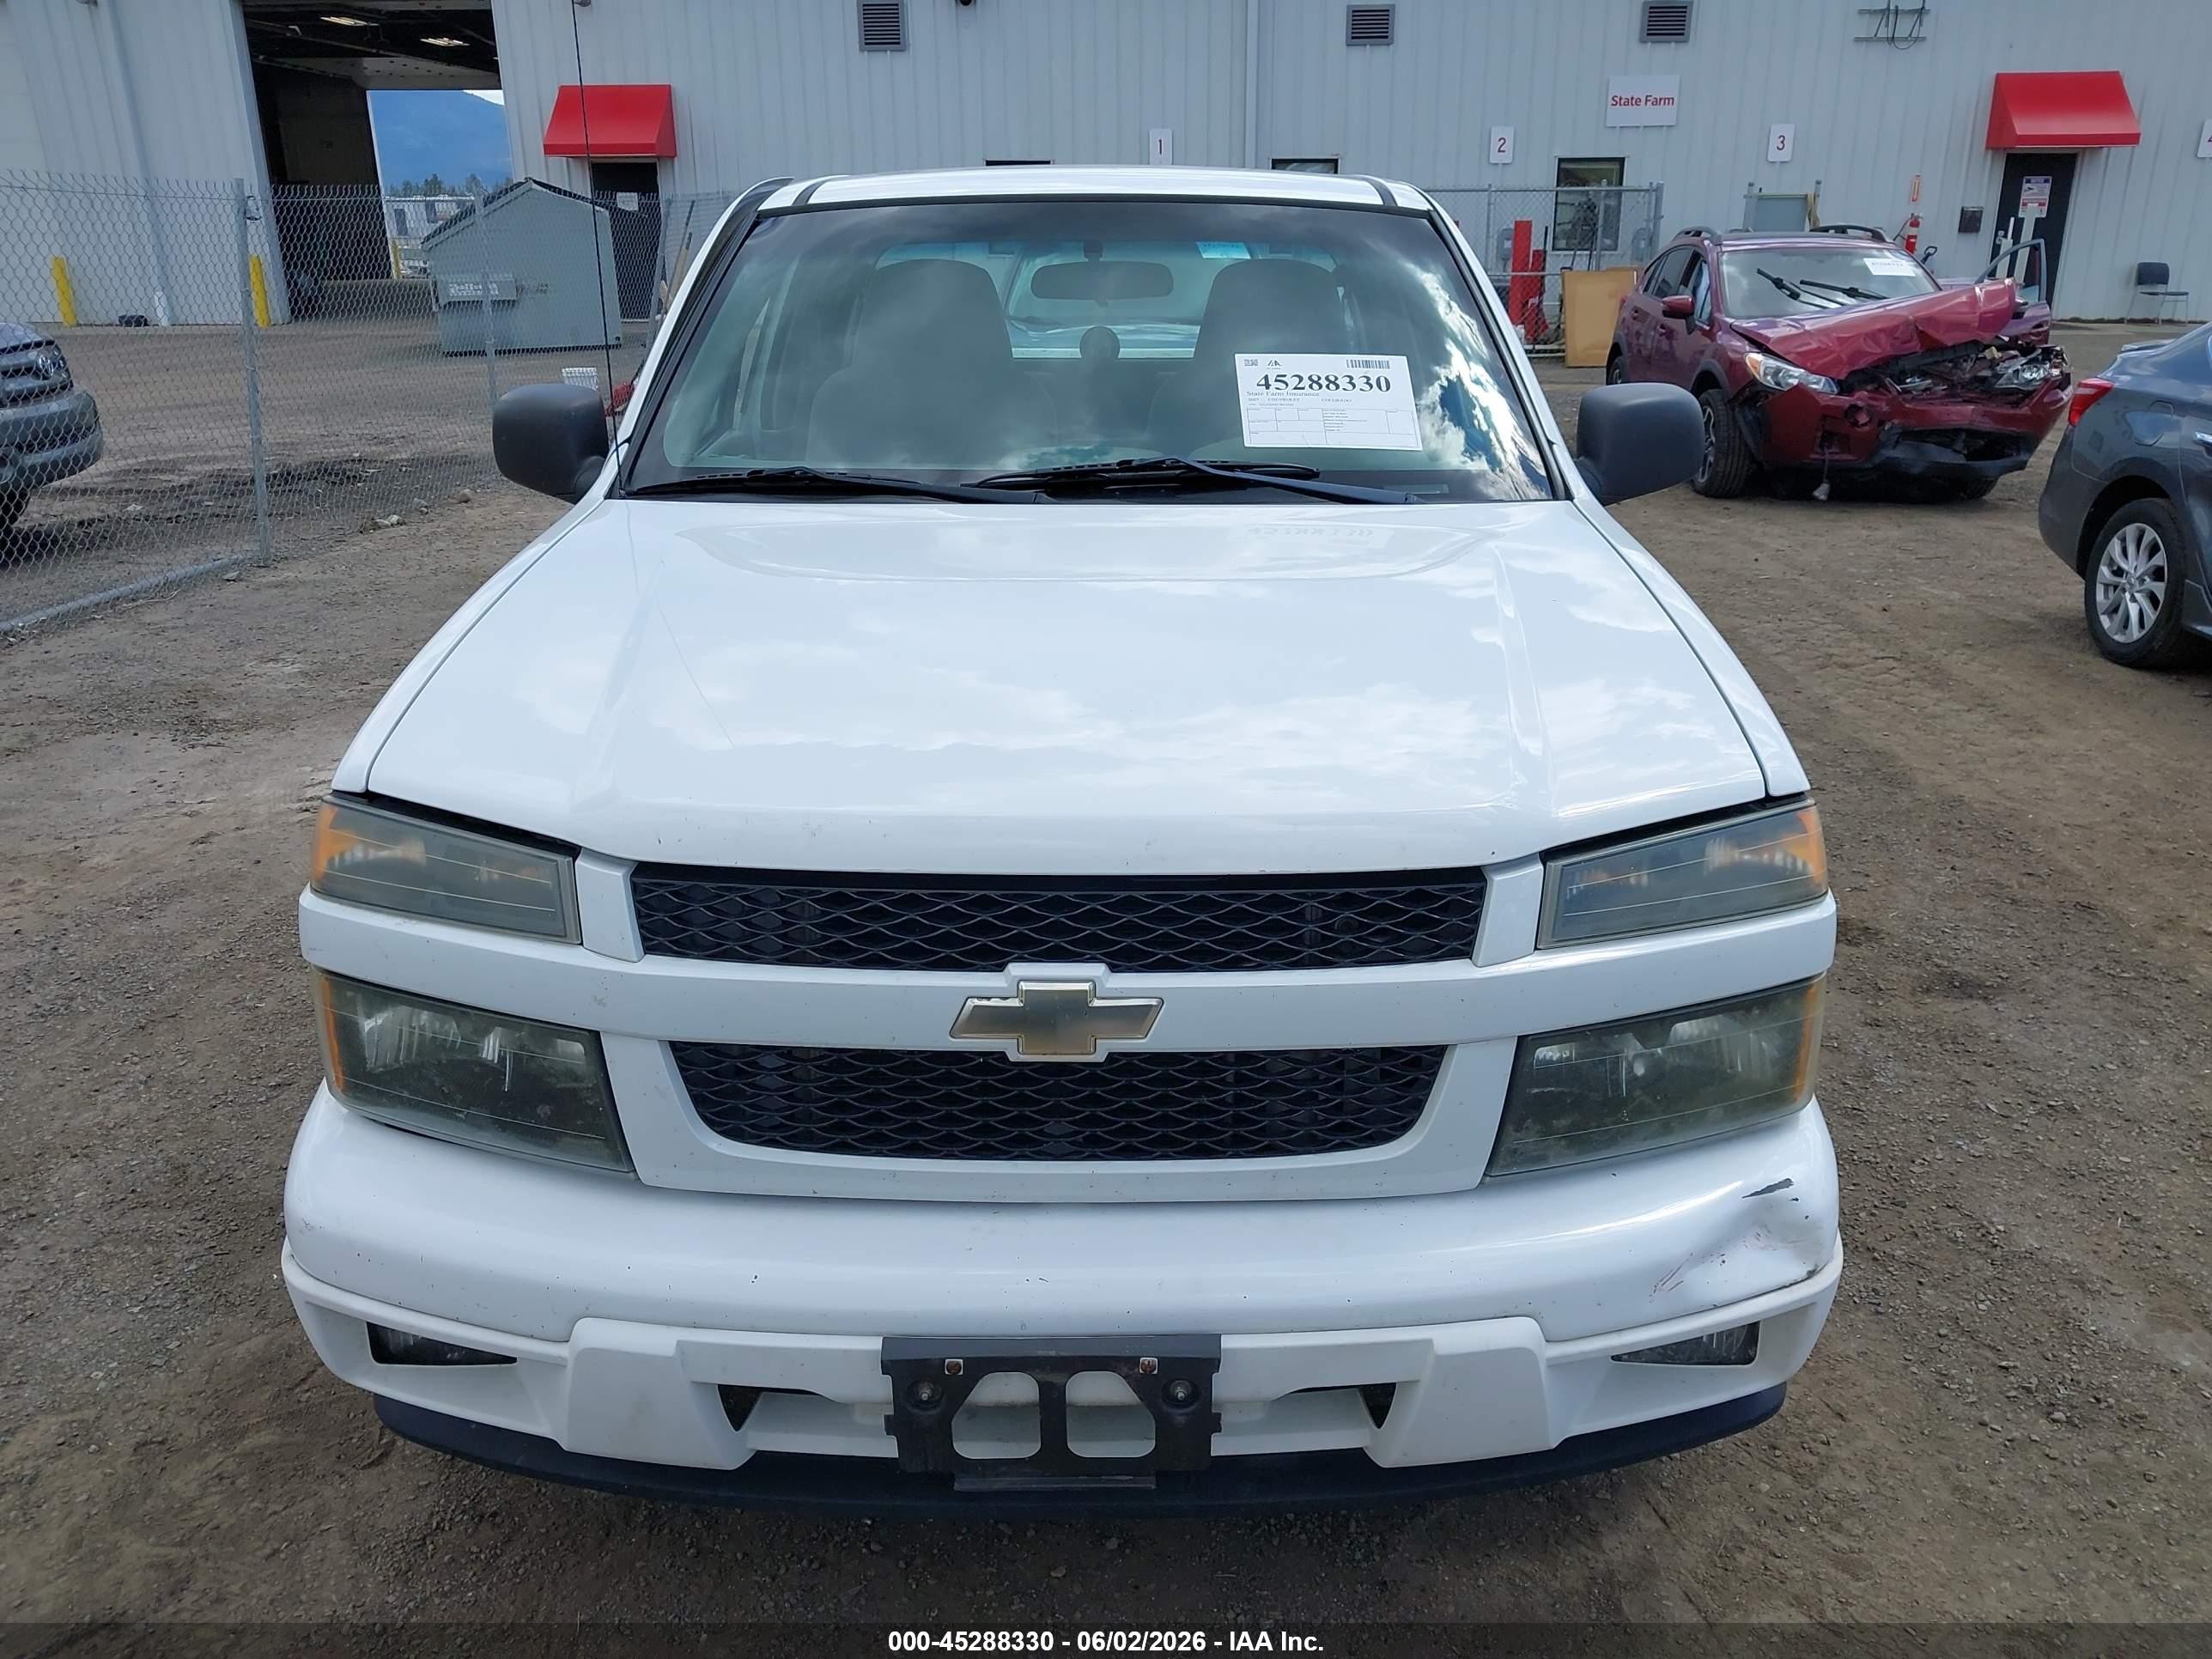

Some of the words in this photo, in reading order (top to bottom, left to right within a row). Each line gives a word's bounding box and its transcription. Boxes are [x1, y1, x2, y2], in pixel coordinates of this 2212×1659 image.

[1611, 94, 1642, 106] State
[1644, 94, 1674, 106] Farm
[1158, 138, 1163, 155] 1
[1497, 137, 1507, 154] 2
[1776, 134, 1786, 151] 3
[1256, 373, 1391, 392] 45288330
